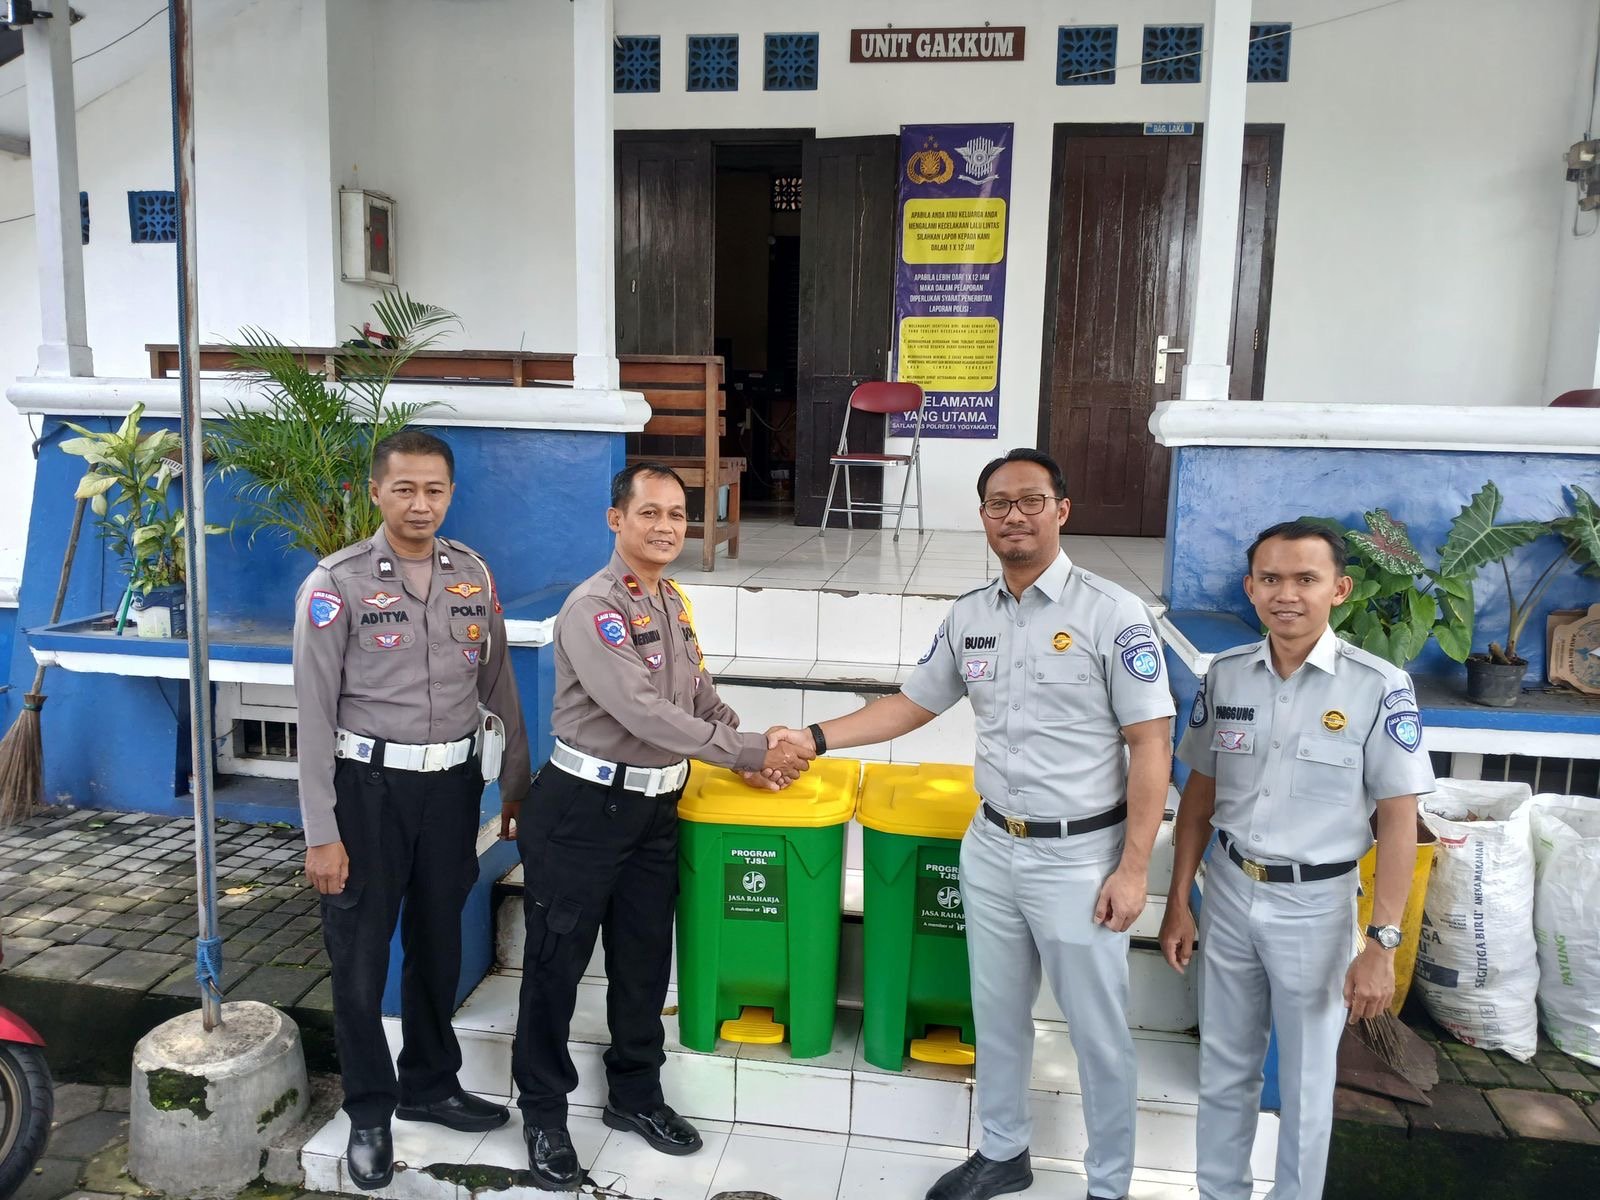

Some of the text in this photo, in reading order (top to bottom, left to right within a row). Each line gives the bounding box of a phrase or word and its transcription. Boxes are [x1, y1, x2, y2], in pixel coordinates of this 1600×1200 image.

[860, 32, 1014, 58] UNIT GAKKUM
[1153, 124, 1184, 133] BAG. LAKA
[925, 396, 993, 407] ELAMATAN
[903, 411, 987, 422] YANG UTAMA
[450, 605, 486, 616] POLRI
[360, 610, 409, 625] ADITYA
[965, 636, 996, 650] BUDHI
[926, 864, 960, 873] PROGR
[762, 906, 777, 914] IFG
[956, 922, 966, 931] IF
[1474, 912, 1485, 940] BIRU
[1474, 942, 1488, 988] SEGITIGA
[1555, 934, 1573, 986] PAYUNG
